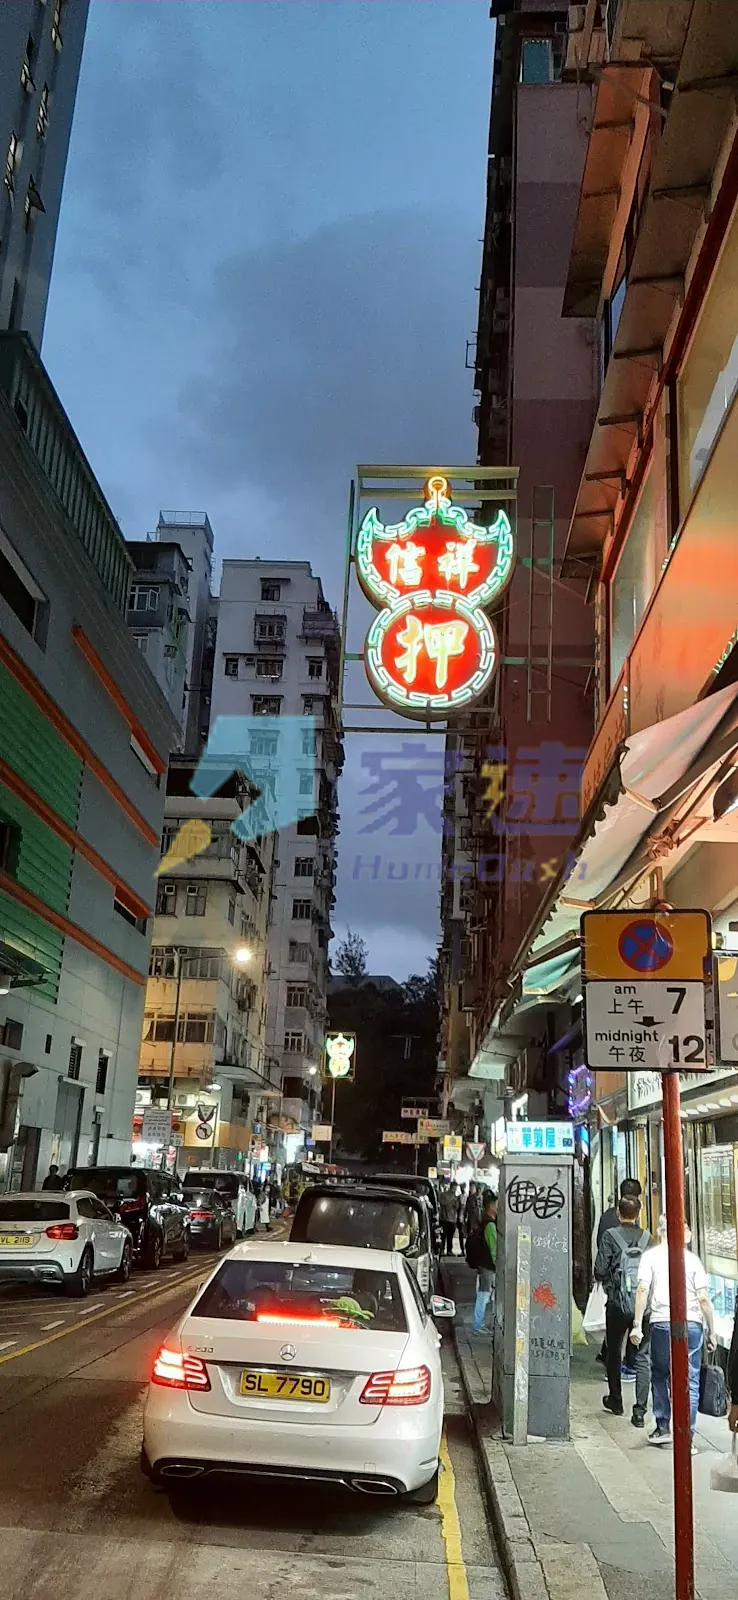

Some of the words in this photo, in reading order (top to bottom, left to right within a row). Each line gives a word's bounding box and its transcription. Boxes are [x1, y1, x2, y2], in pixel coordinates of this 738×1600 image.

[395, 615, 469, 689] 押
[614, 985, 636, 995] am
[608, 998, 644, 1015] 上午
[666, 987, 687, 1015] 7
[595, 1030, 659, 1044] midnight
[608, 1046, 646, 1063] 午夜
[668, 1035, 705, 1063] 12
[245, 1374, 268, 1392] SL
[276, 1376, 326, 1397] 7790
